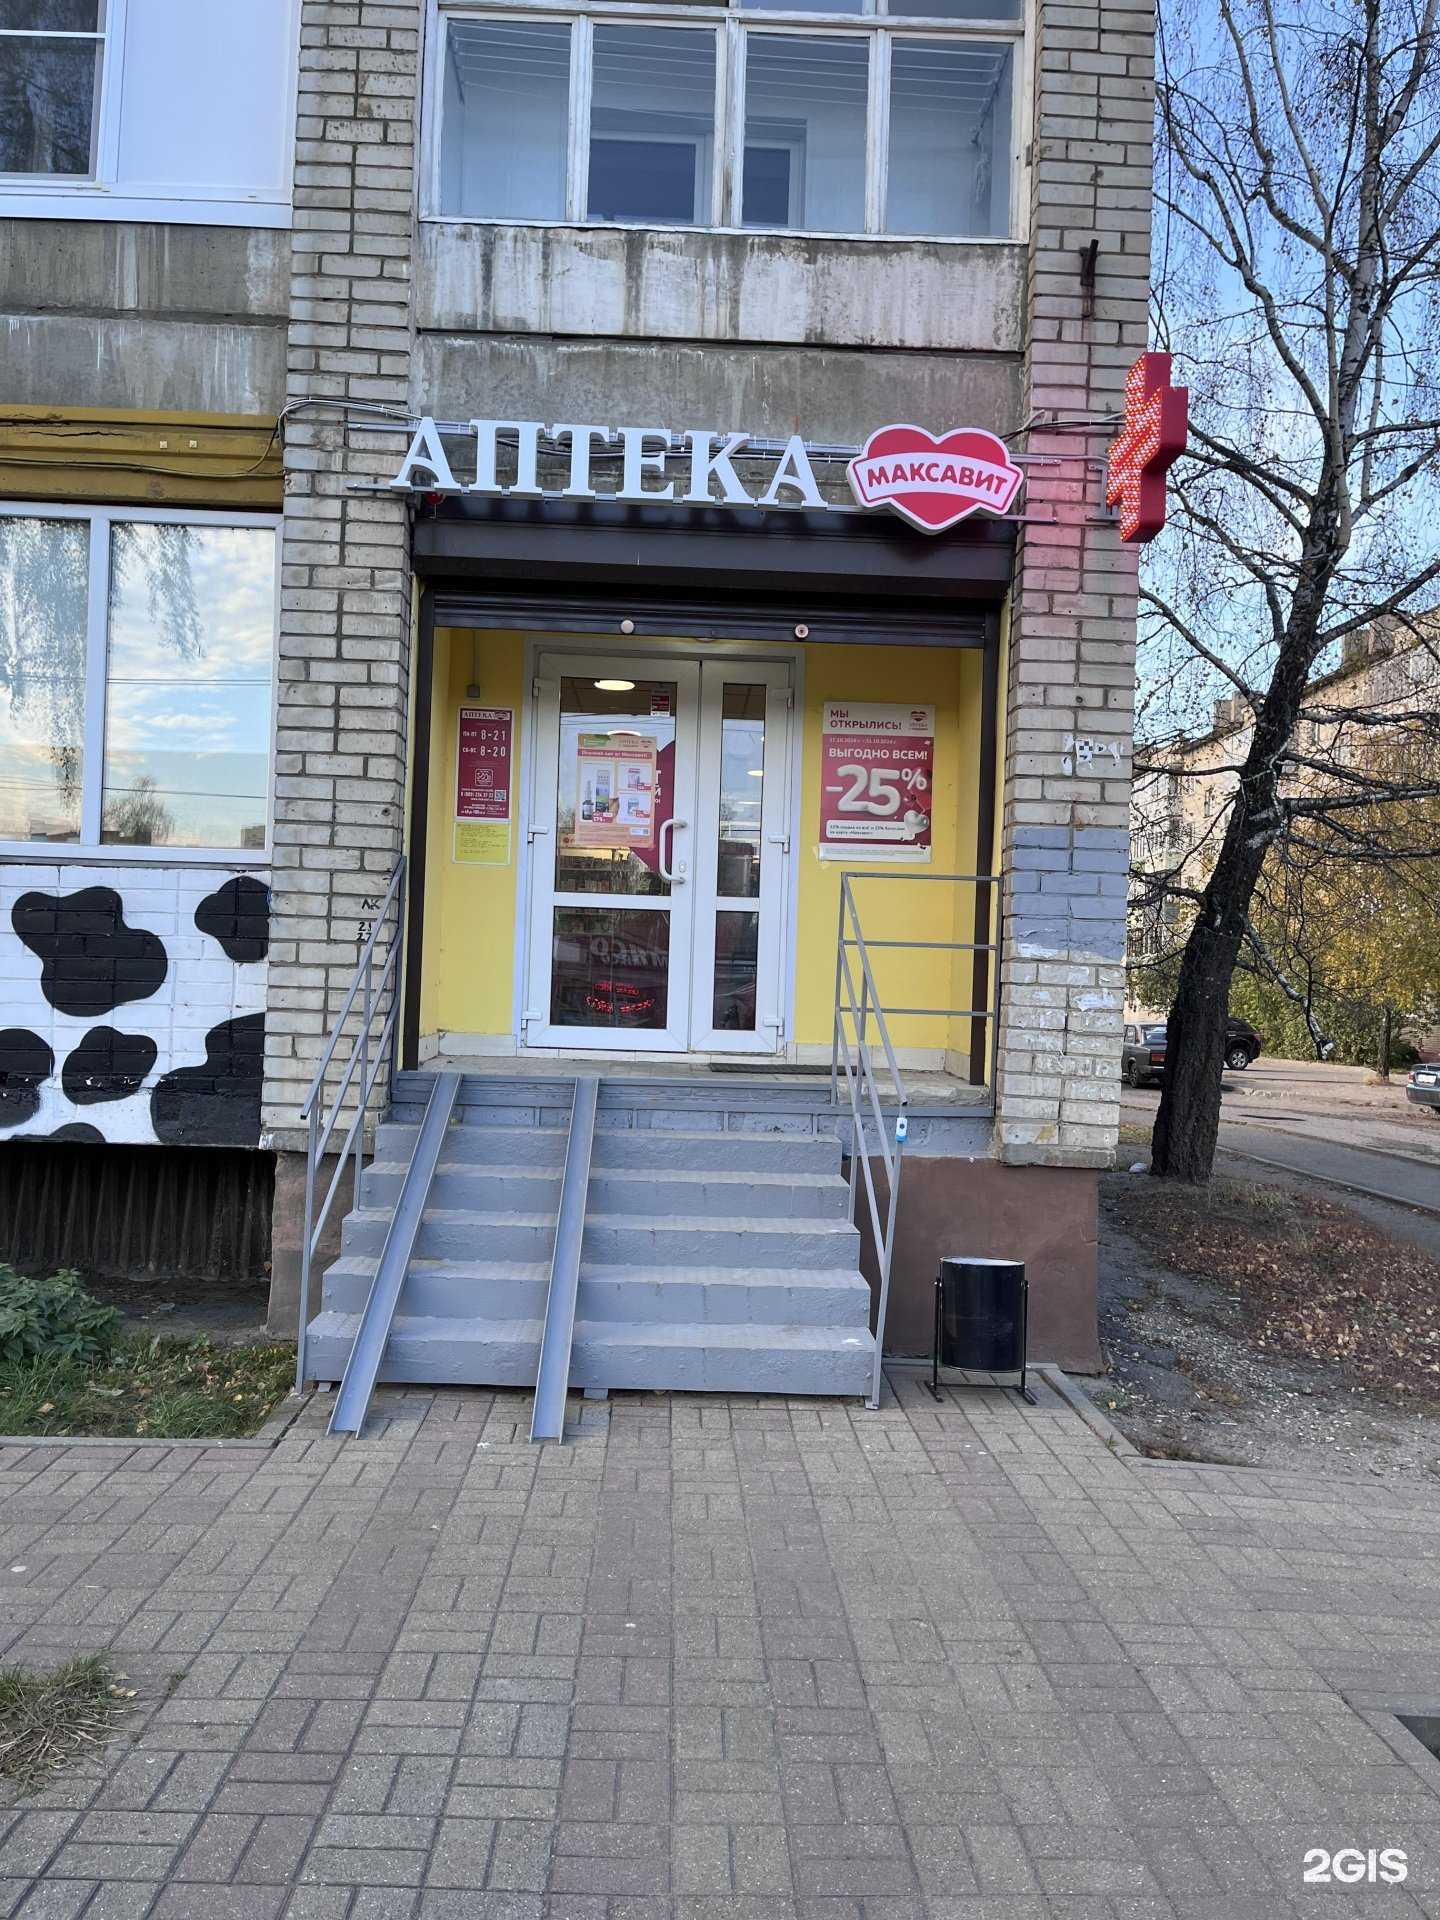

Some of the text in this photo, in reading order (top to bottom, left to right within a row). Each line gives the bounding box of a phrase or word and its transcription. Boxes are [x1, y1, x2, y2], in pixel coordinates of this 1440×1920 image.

[390, 415, 829, 509] АПТЕКА
[866, 461, 1009, 497] МАКСАВИТ
[830, 709, 849, 718] МЫ
[830, 719, 902, 730] ОТКРЫЛИСЬ!
[828, 747, 928, 761] ВЫГОДНО ВСЕМ!
